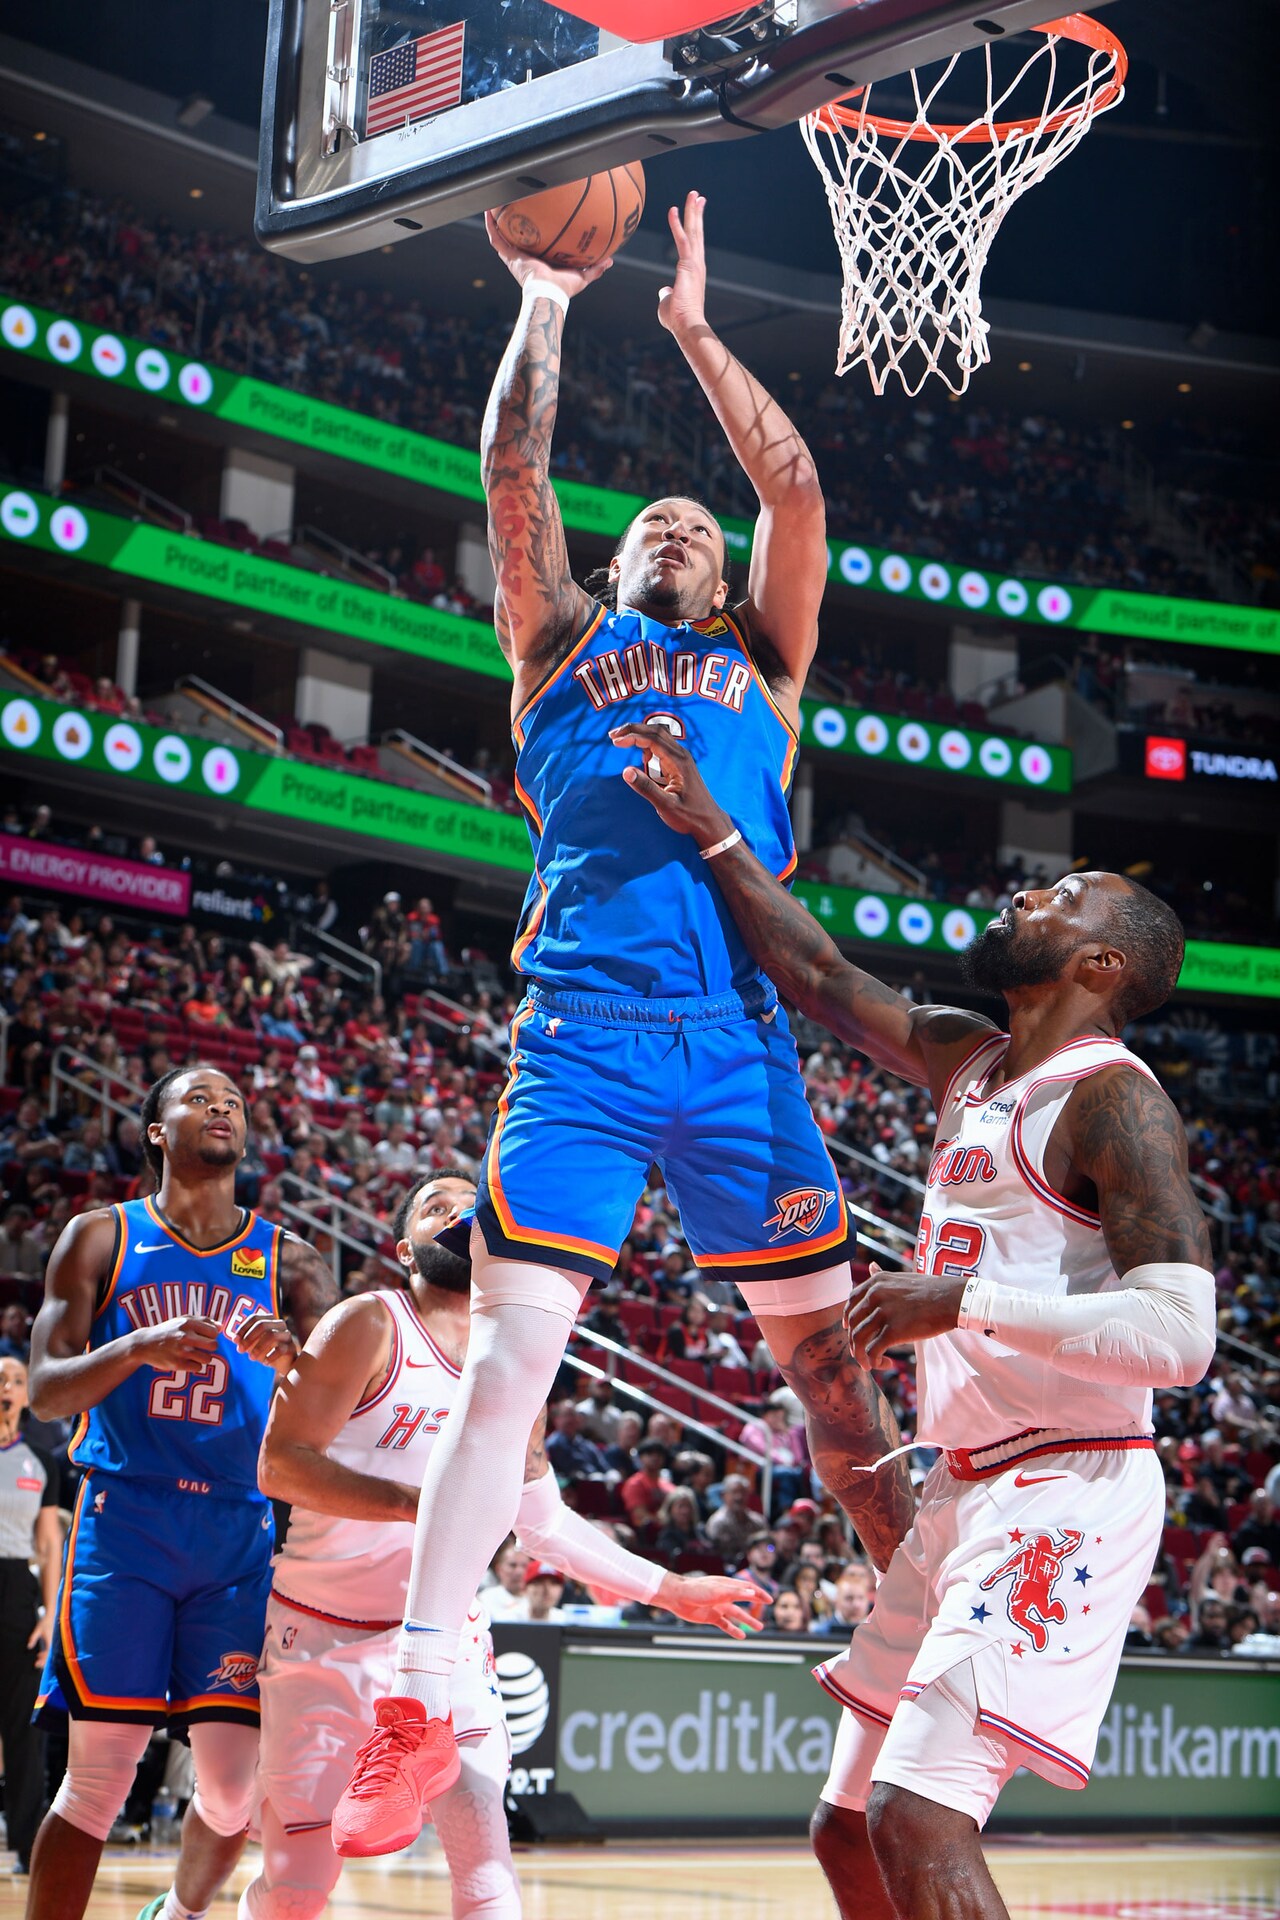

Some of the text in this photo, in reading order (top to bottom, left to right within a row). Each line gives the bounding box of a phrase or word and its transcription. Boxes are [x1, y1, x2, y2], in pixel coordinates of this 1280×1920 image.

[250, 392, 308, 429] Proud
[311, 415, 382, 450] partner
[387, 440, 407, 459] of
[411, 446, 440, 471] the
[165, 545, 228, 582] Proud
[233, 567, 313, 607] partner
[317, 592, 339, 614] of
[342, 598, 374, 625] the
[380, 606, 463, 649] Houston
[1110, 600, 1171, 626] Proud
[1175, 613, 1250, 638] partner
[572, 640, 752, 714] THUNDER
[1189, 751, 1278, 782] TUNDRA
[282, 773, 346, 812] Proud
[351, 795, 429, 830] partner
[434, 814, 456, 835] of
[461, 818, 495, 844] the
[10, 848, 85, 884] ENERGY
[90, 862, 182, 902] PROVIDER
[193, 889, 253, 920] reliant
[1185, 952, 1250, 978] Proud
[780, 1195, 818, 1231] OKC
[148, 1353, 230, 1425] 22
